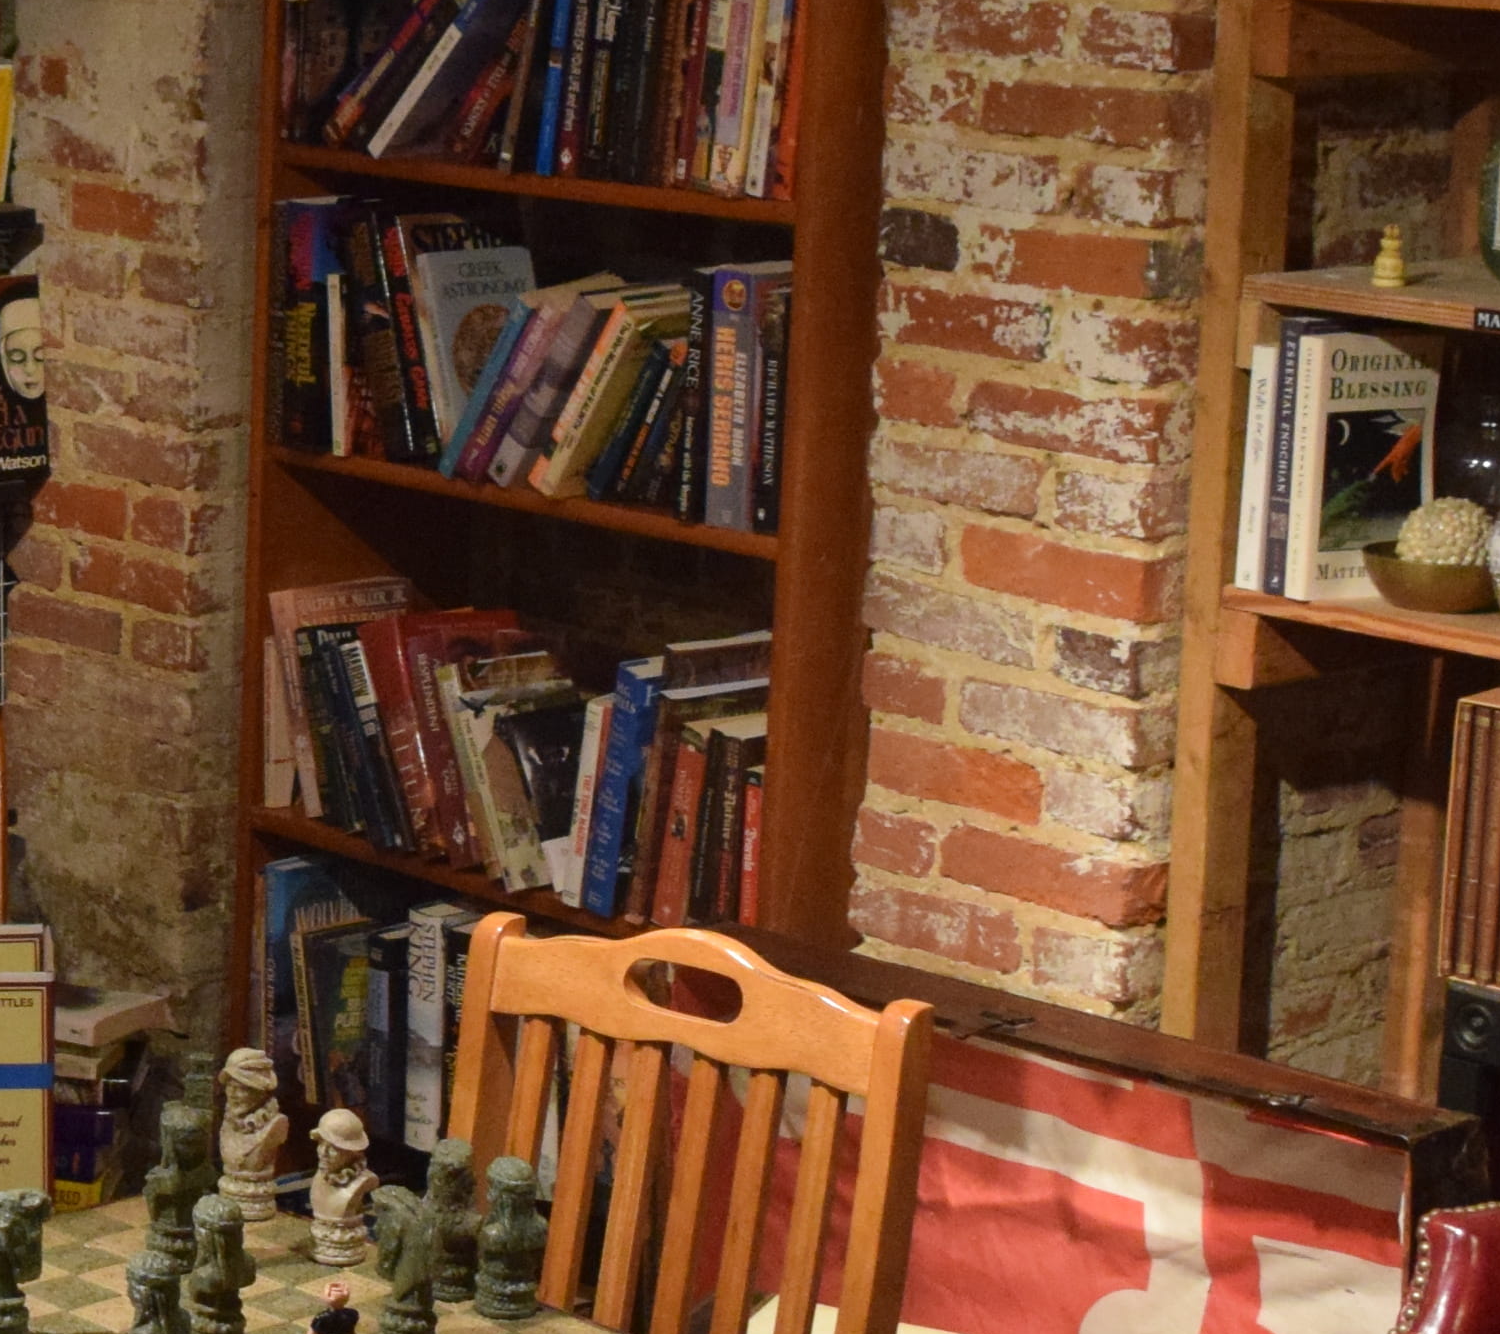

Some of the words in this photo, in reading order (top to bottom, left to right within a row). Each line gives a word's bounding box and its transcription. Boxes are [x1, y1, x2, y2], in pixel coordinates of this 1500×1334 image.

[442, 277, 528, 299] ASTRONOMY
[457, 261, 505, 278] GREEK
[688, 290, 705, 343] ANNE
[684, 347, 701, 389] RICE
[714, 326, 736, 392] HERIS
[732, 352, 747, 424] ELIZABETH
[763, 358, 779, 414] RICHARD
[1281, 340, 1297, 418] ESSENTIAL
[1329, 377, 1428, 401] BLESSING
[1330, 349, 1428, 374] ORIGINAL
[710, 395, 733, 487] SERRANO
[731, 428, 745, 467] MOON
[761, 418, 777, 487] MATHESON
[1275, 422, 1291, 493] ENOCHIAN
[407, 920, 423, 996] KING
[420, 922, 437, 1005] STEPHEN
